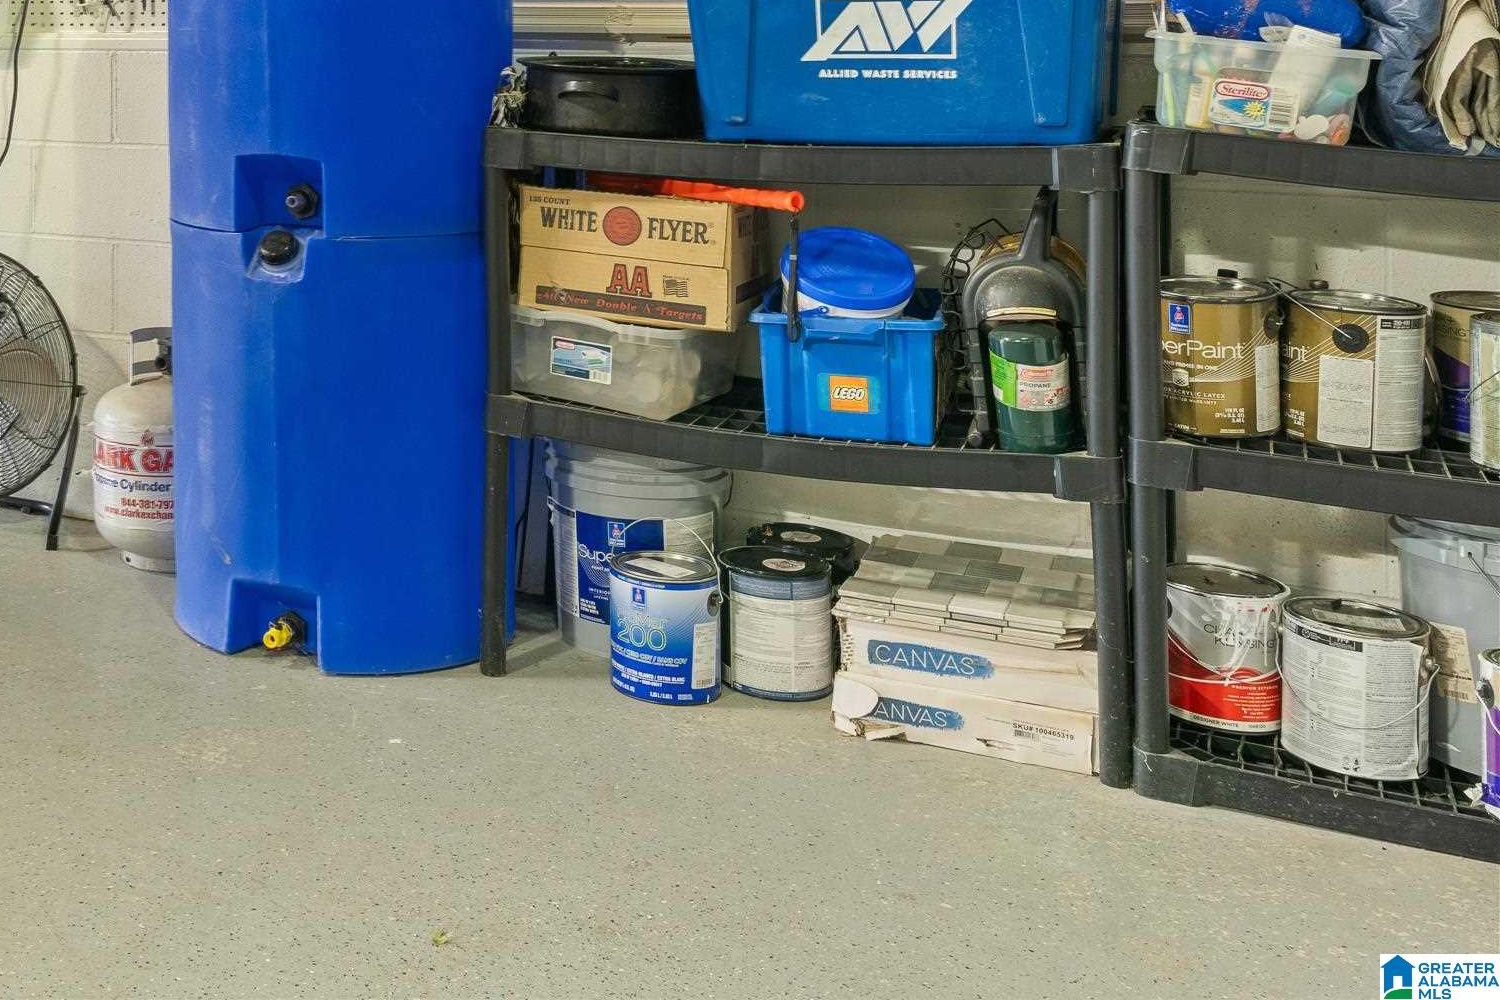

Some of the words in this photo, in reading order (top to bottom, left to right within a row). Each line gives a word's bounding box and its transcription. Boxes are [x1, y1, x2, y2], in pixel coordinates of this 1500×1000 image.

[819, 68, 858, 79] ALLIED
[861, 69, 899, 79] WASTE
[903, 69, 957, 80] SERVICES
[1220, 83, 1267, 99] Sterilite
[543, 197, 570, 206] COUNT
[540, 205, 598, 233] WHITE
[647, 216, 710, 245] FLYER
[606, 263, 652, 299] AA
[596, 297, 637, 313] Double
[657, 306, 703, 321] Targets
[833, 385, 866, 400] LEGO
[1020, 381, 1051, 389] PROPANE
[93, 440, 137, 472] LARK
[141, 448, 173, 473] GA
[120, 479, 172, 492] Cylinder
[121, 496, 173, 510] 844-381-797
[104, 506, 173, 520] www.clarkexchan
[578, 543, 613, 563] Supe
[617, 619, 667, 651] 200
[875, 644, 975, 675] CANVAS
[874, 702, 947, 727] ANVAS
[1012, 722, 1033, 731] SKU#
